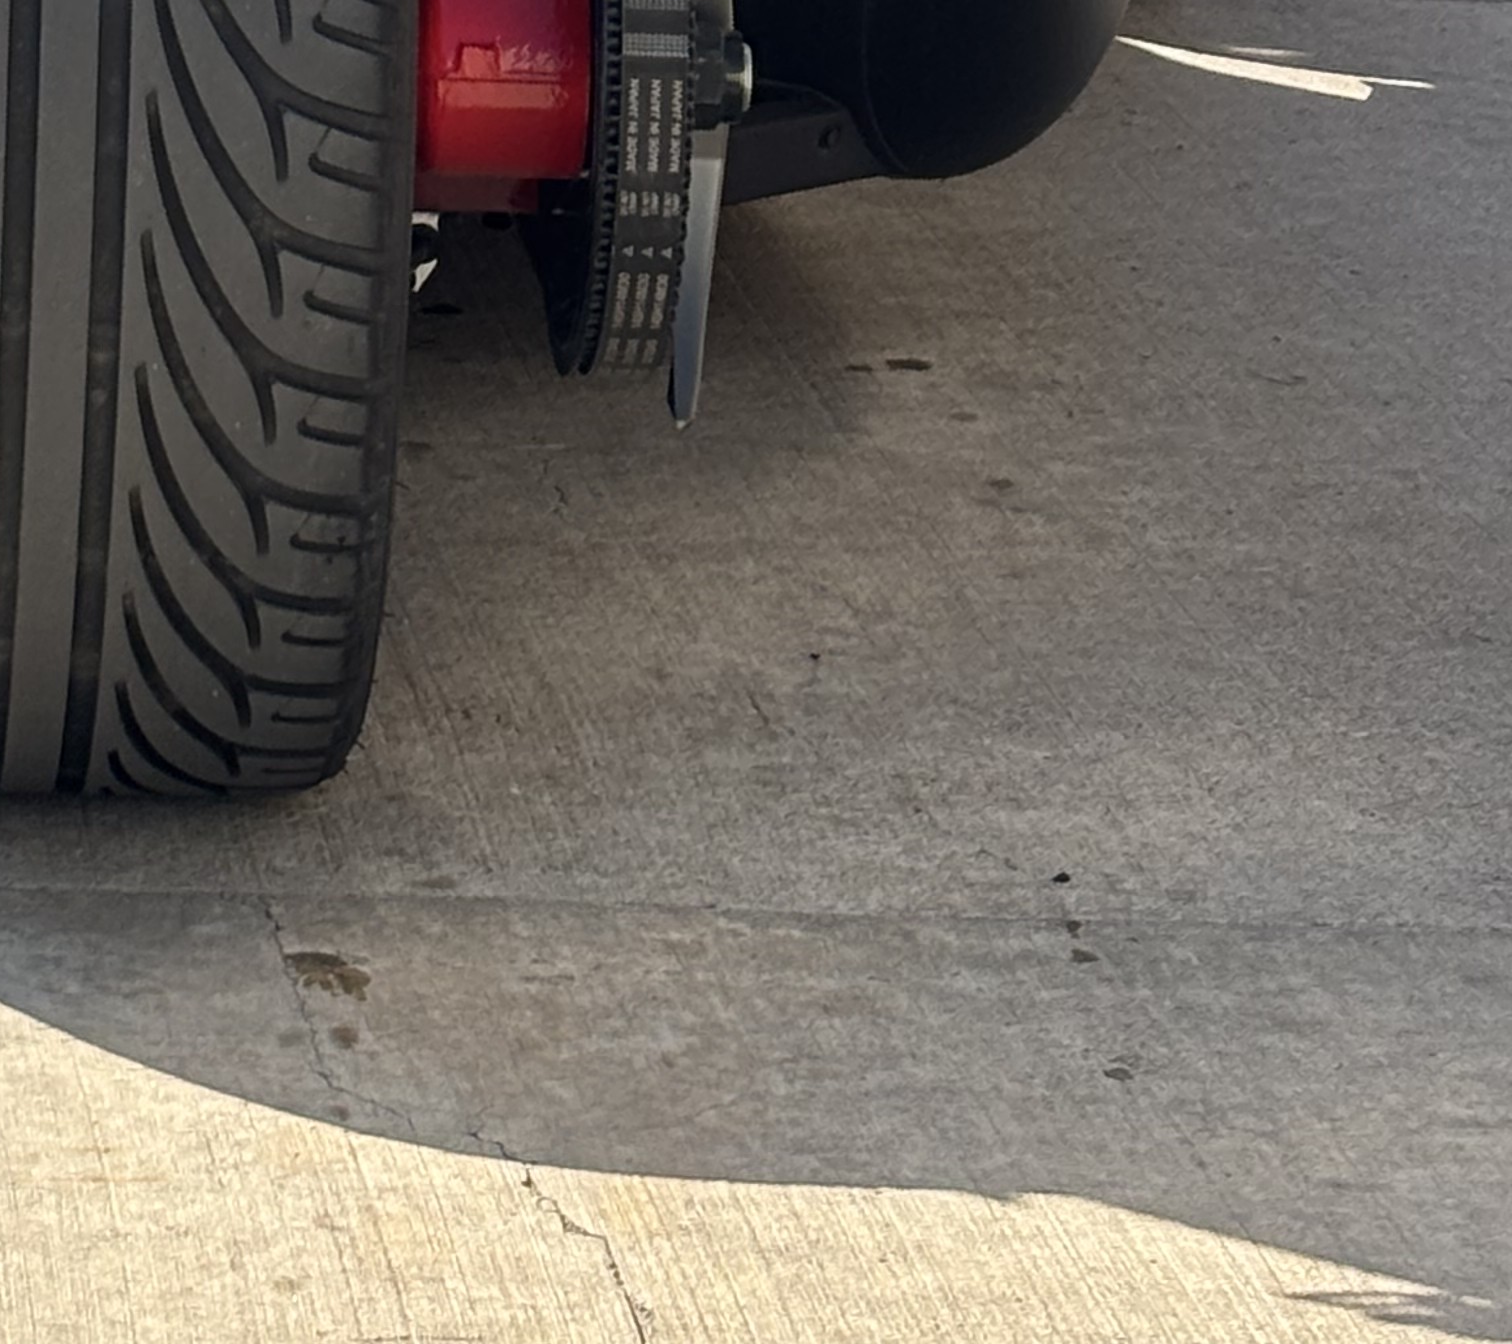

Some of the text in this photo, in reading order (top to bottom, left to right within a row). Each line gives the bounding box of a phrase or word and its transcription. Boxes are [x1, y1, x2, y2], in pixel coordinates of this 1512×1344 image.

[625, 78, 640, 172] MADE IN JAPAN
[647, 79, 661, 172] MADE IN JAPAN
[669, 80, 683, 173] MADE IN JAPAN
